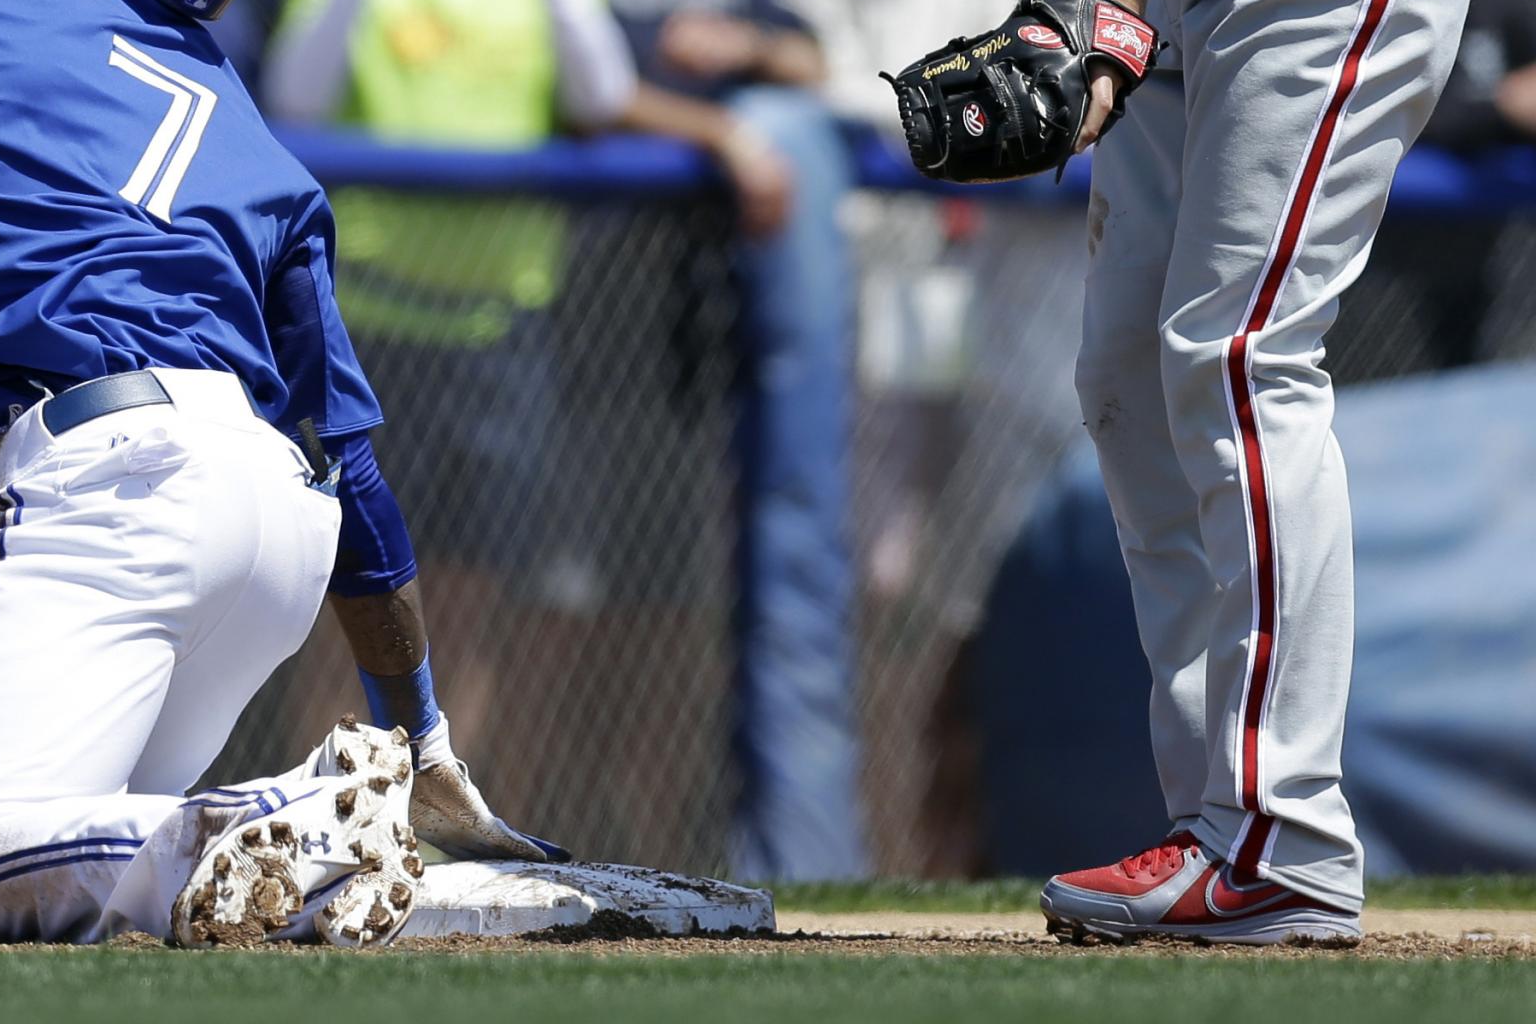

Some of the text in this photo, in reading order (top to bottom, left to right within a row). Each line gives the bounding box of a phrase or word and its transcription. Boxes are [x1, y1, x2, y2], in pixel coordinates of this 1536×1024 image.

[922, 33, 1011, 80] Mike Young
[108, 34, 218, 224] 7
